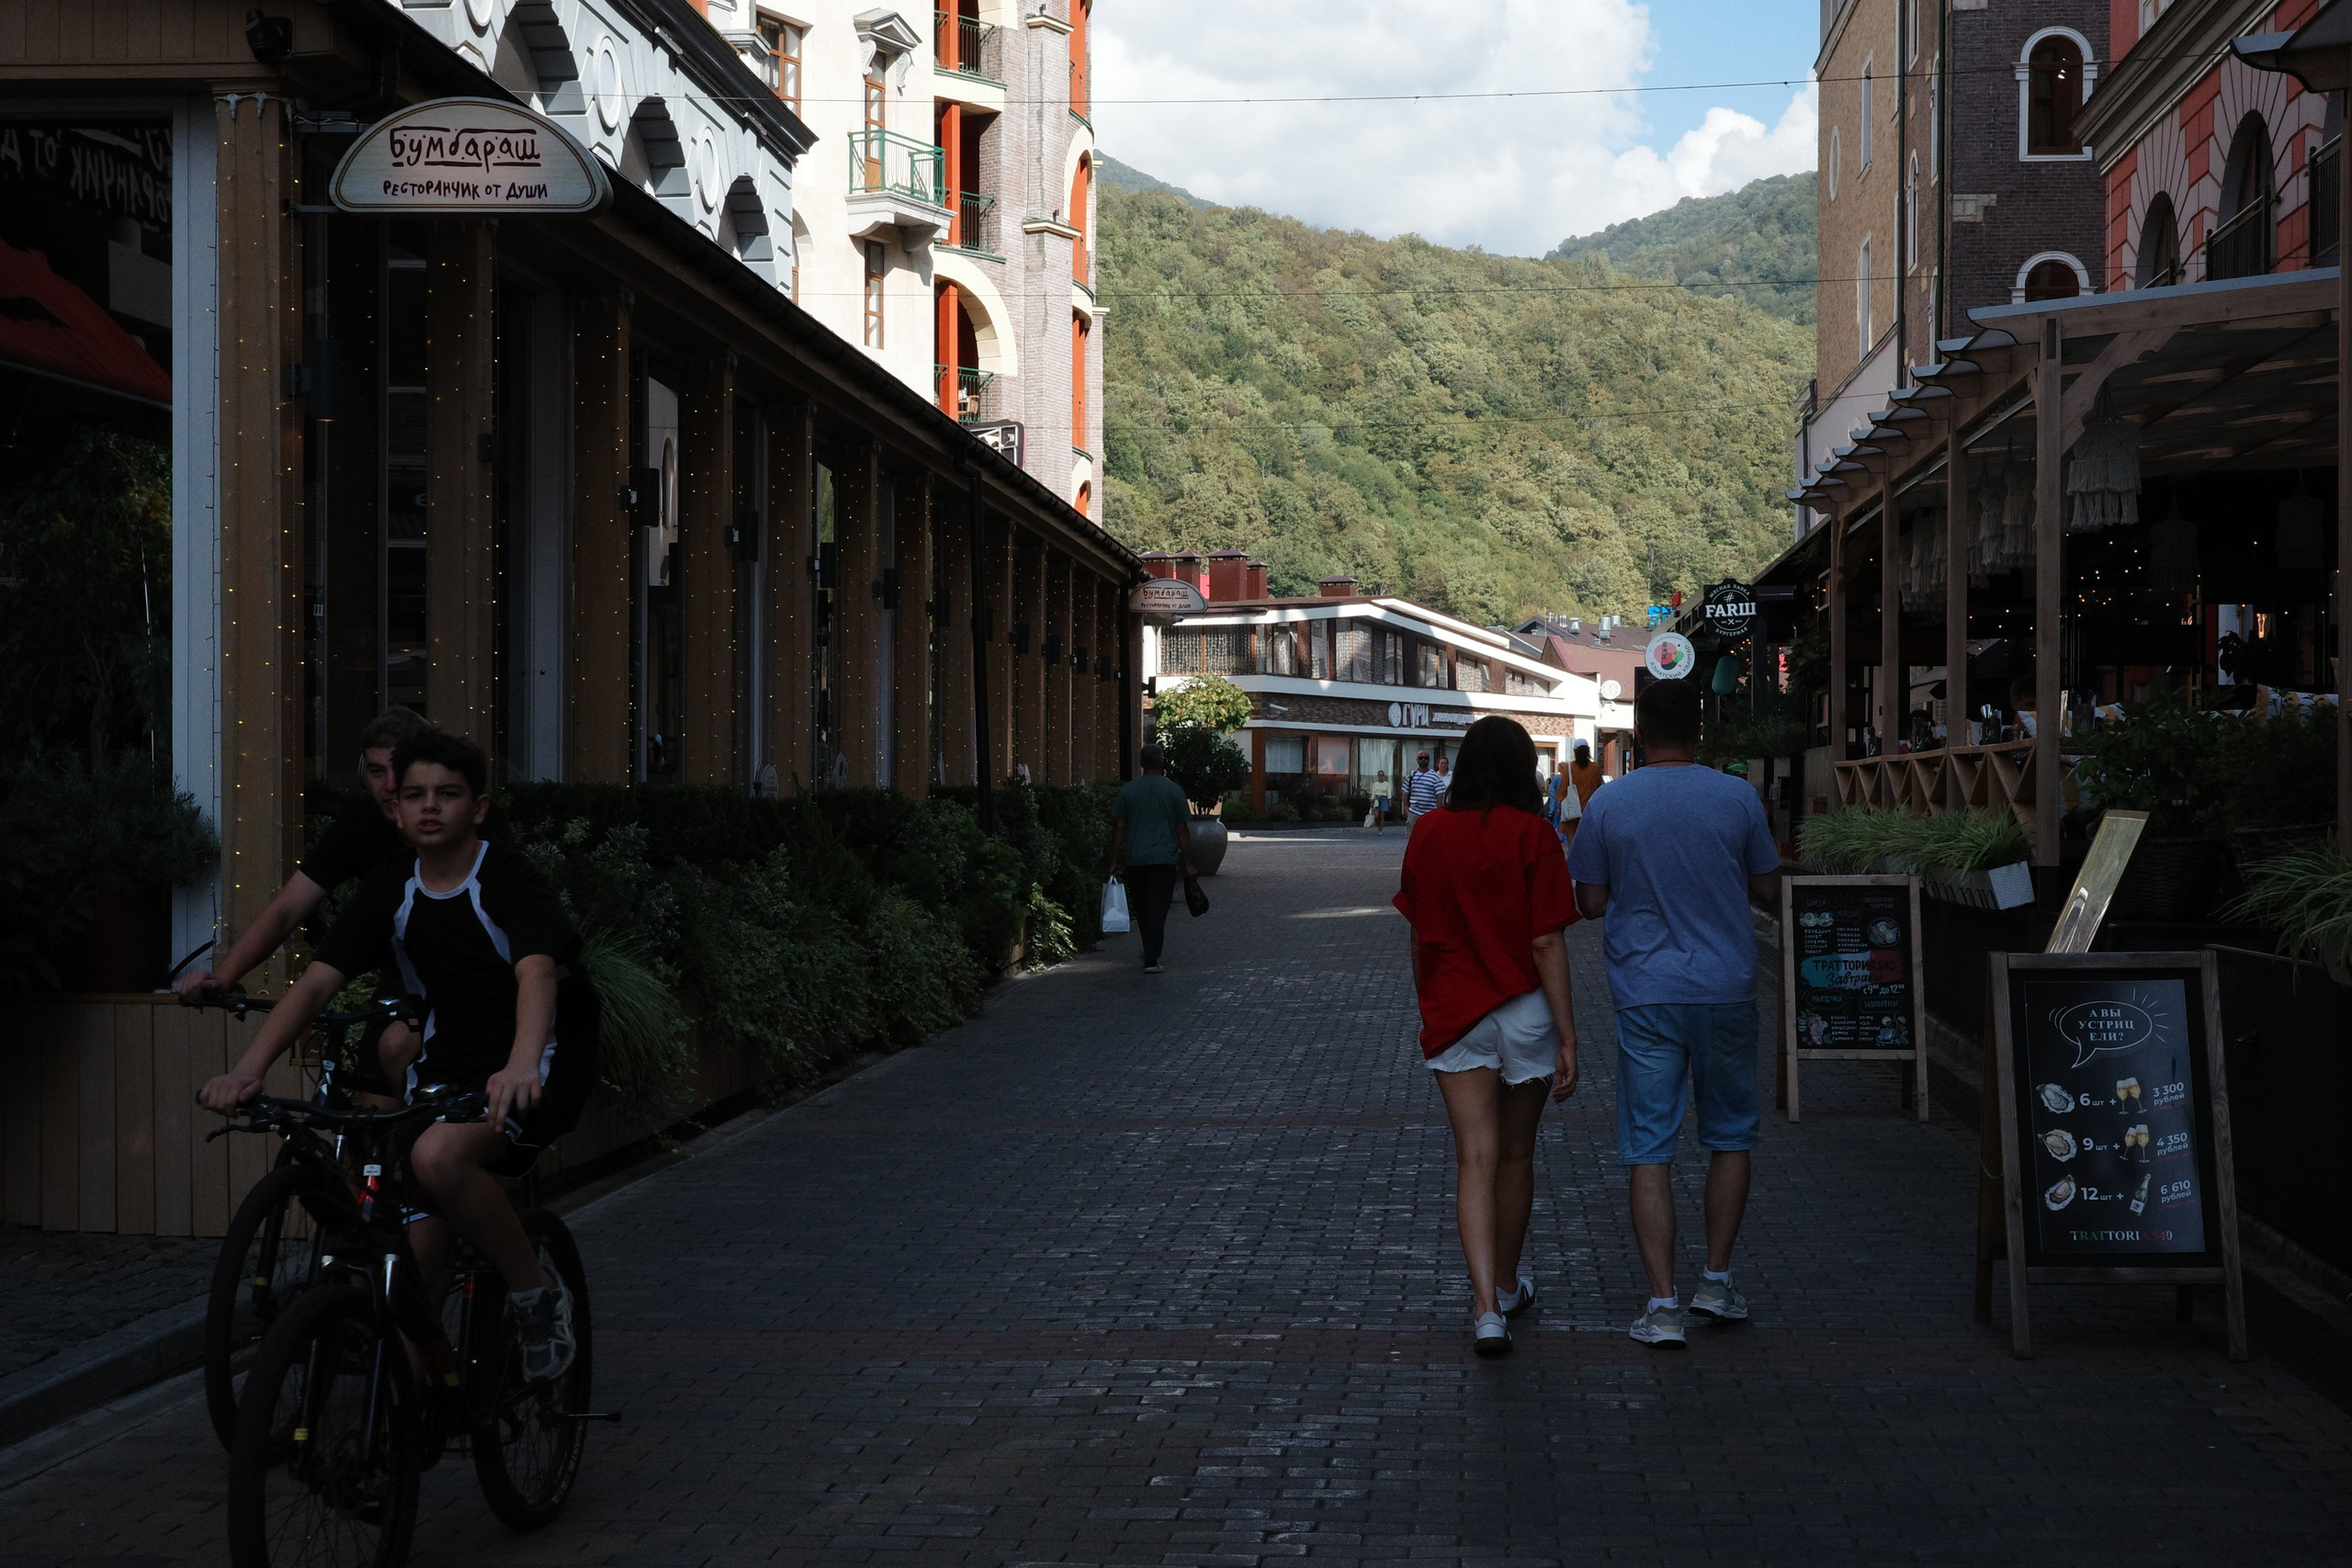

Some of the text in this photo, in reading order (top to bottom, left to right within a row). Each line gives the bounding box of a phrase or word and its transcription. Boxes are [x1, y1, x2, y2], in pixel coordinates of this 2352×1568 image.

[382, 180, 548, 199] РЕСТОРАНЧИК ОТ ДУШИ
[1709, 583, 1750, 598] МЯСНАЯ ЛАВКА
[1715, 626, 1748, 637] БУРГЕРНАЯ
[1649, 661, 1682, 679] АЗИАТСКИЙ
[1682, 645, 1692, 672] КВАРТАЛ
[1403, 704, 1429, 728] ГУРИ
[2089, 1009, 2121, 1018] А ВЫ
[2077, 1021, 2135, 1031] УСТРИЦ
[2089, 1032, 2124, 1042] ЕЛИ?
[2153, 1093, 2186, 1107] рублей
[2156, 1142, 2189, 1156] рублей
[2161, 1190, 2192, 1204] рублей
